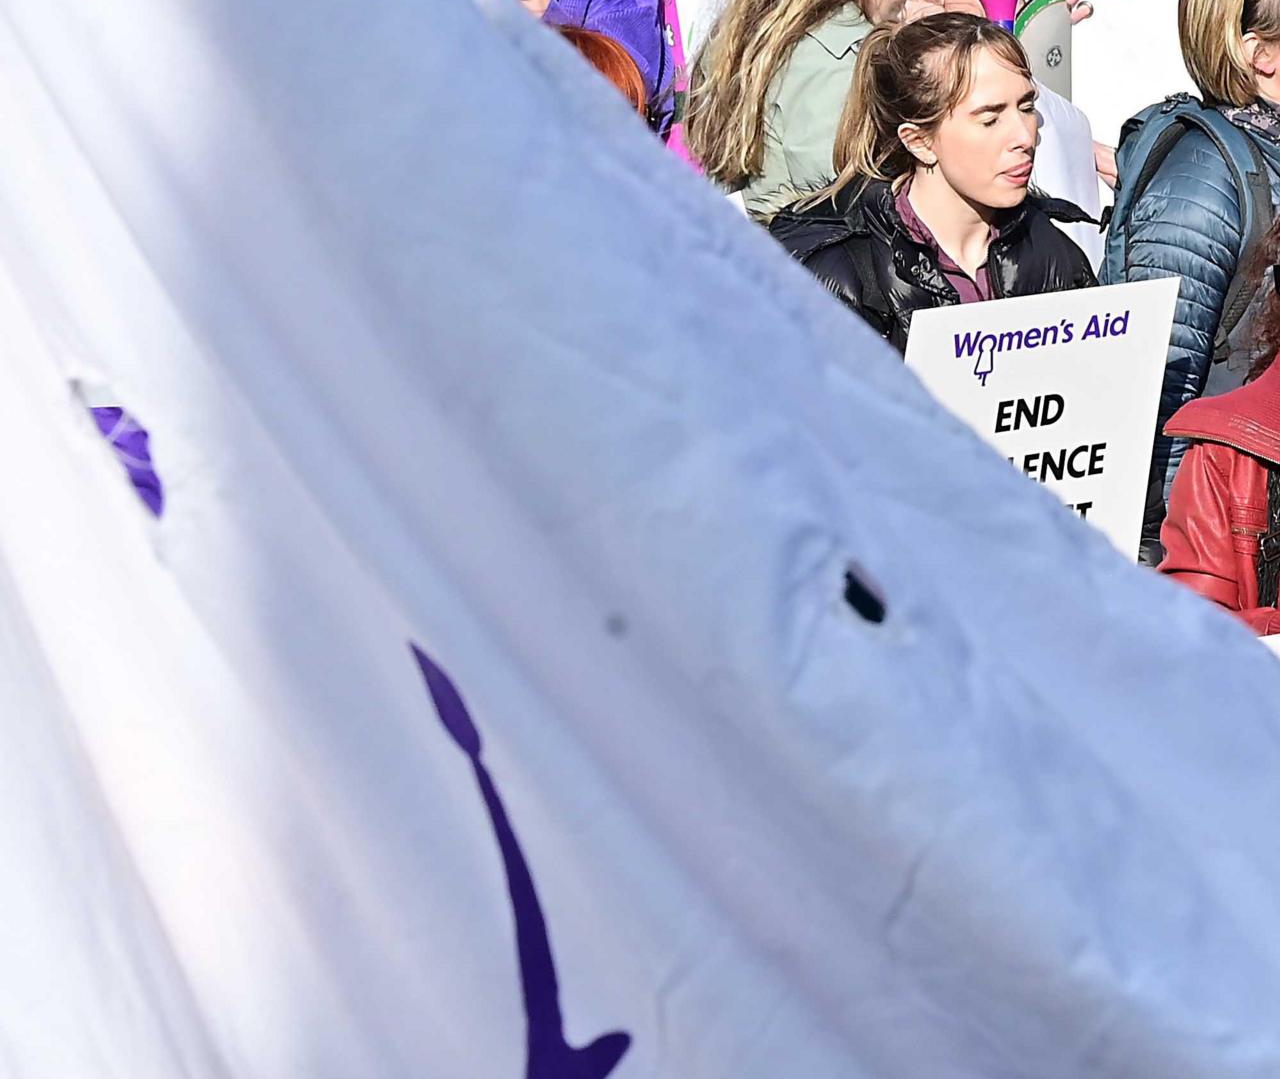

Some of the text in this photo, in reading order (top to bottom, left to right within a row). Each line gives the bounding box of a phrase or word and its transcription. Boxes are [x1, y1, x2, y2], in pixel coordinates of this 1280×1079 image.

[954, 311, 1130, 375] Women's Aid
[994, 393, 1065, 433] END
[1008, 442, 1107, 482] ENCE
